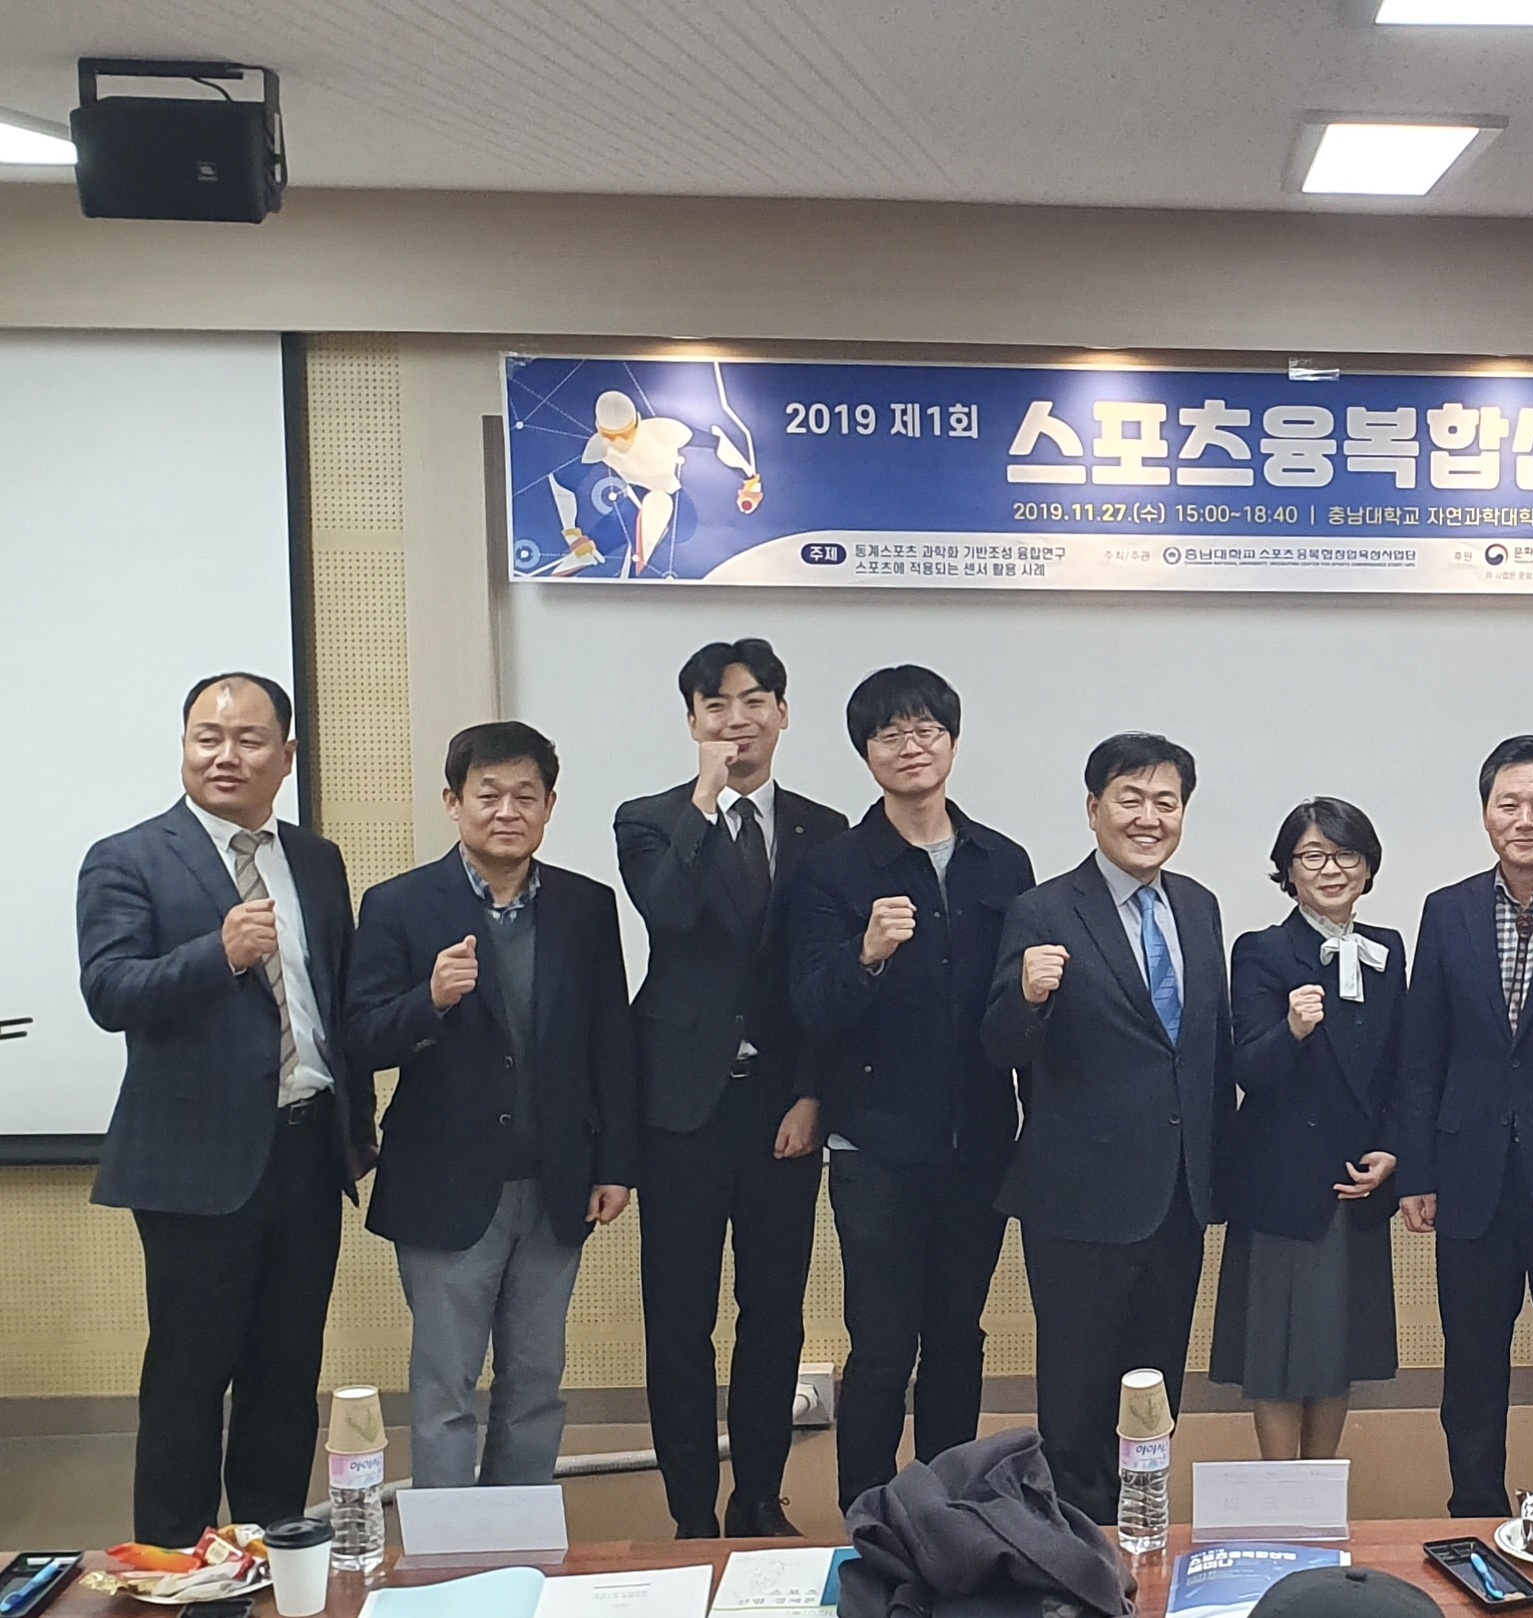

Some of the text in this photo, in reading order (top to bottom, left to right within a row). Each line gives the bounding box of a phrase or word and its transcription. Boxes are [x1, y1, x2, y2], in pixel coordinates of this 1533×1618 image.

[785, 403, 979, 438] 2019 제1회
[1013, 502, 1165, 524] 2019.11.27.(수)
[1175, 504, 1298, 524] 15:00~18:40
[1327, 506, 1420, 526] 충남대학교
[809, 546, 838, 562] 주제
[855, 544, 1066, 561] 동계스포츠 과학화 기반조성 융합연구
[1104, 550, 1150, 562] 주최/주관
[1185, 548, 1256, 560] 충남대학교
[1454, 551, 1473, 562] 후원
[855, 561, 1045, 577] 스포츠에 적용되는 센서 활용 사례
